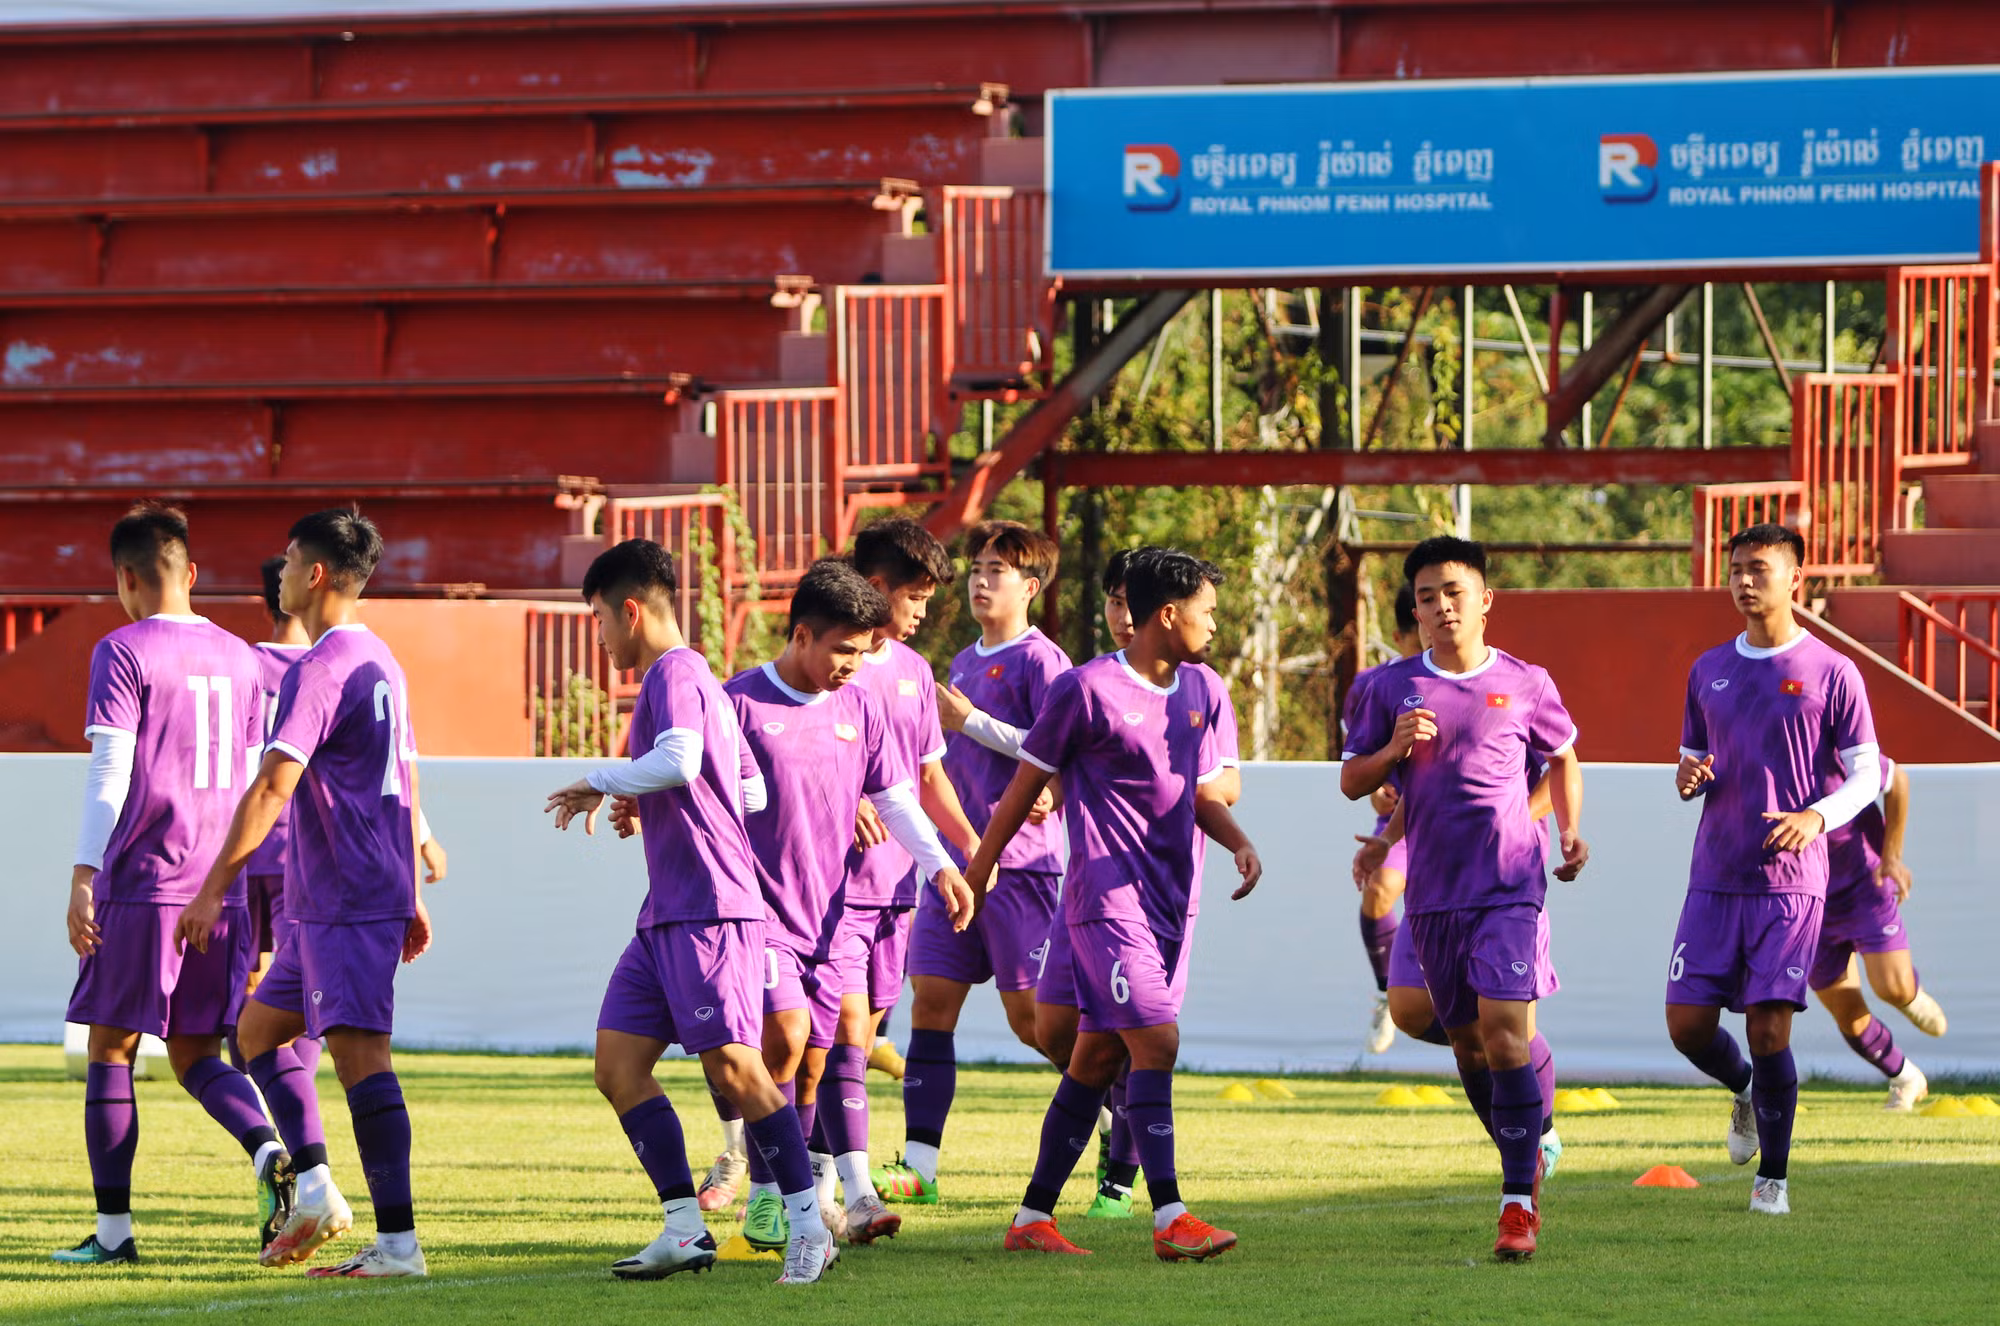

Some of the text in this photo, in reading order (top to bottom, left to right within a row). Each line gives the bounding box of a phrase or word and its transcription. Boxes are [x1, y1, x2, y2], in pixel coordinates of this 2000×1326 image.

[1190, 191, 1492, 215] ROYAL PHNOM PENH HOSPITAL
[1669, 179, 1981, 206] ROYAL PHNOM PENH HOSPITAL
[187, 675, 233, 789] 11
[1110, 960, 1130, 1004] 6
[1670, 942, 1687, 982] 6
